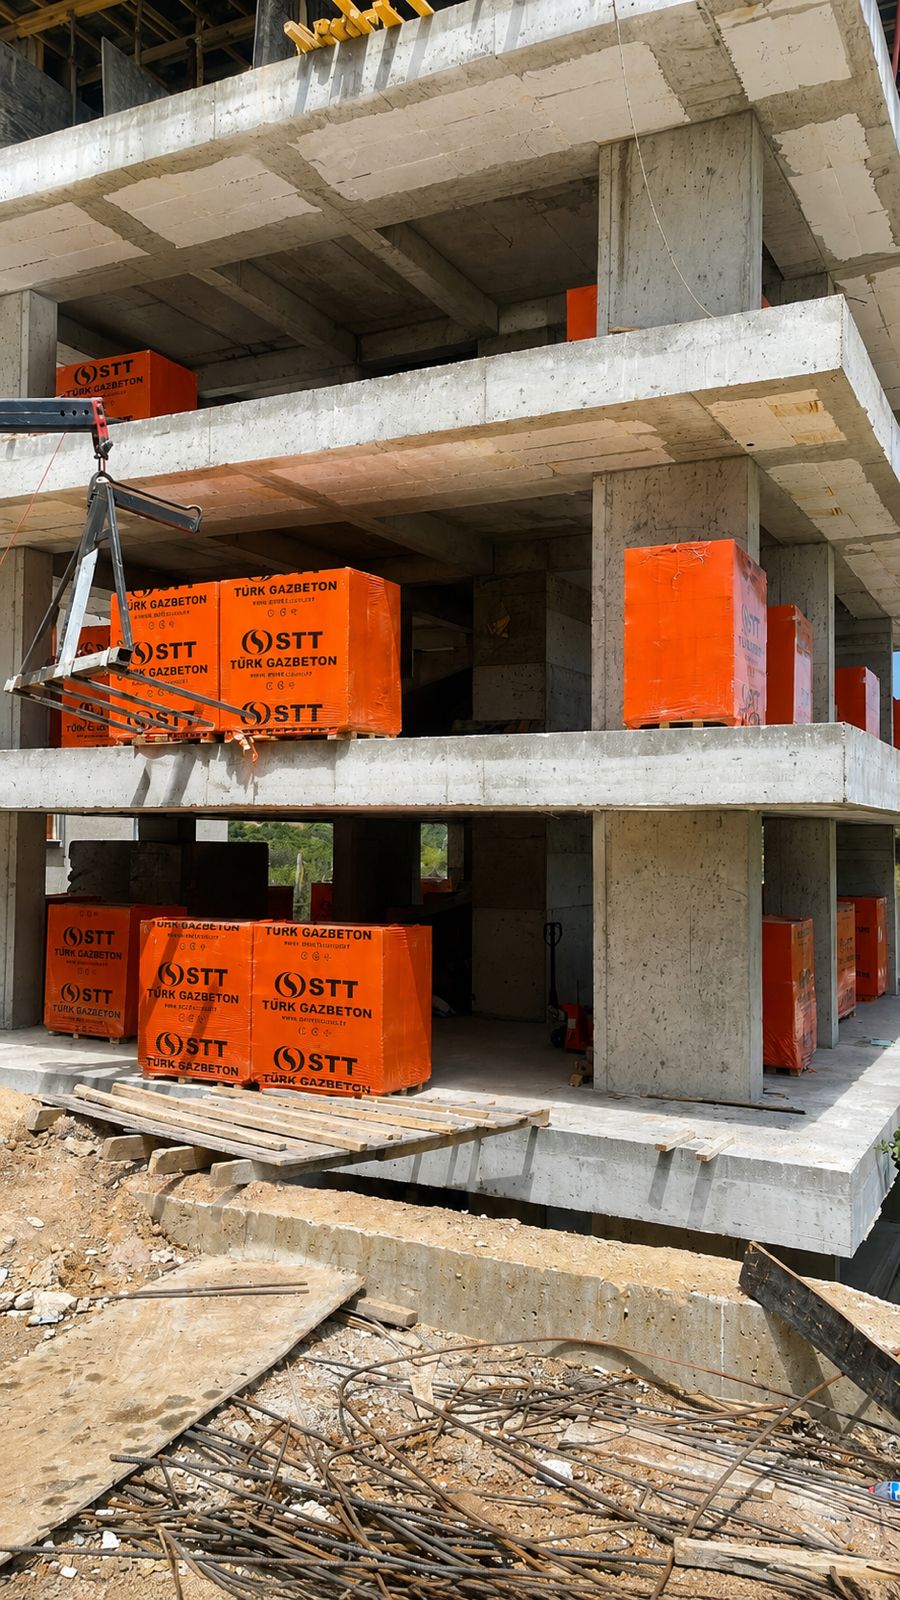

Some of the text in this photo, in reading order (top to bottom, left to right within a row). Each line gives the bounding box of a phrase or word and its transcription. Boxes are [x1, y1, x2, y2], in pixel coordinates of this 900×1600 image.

[100, 360, 133, 379] STT
[269, 581, 337, 595] GAZBETON
[150, 595, 207, 610] GAZBETON
[276, 631, 323, 650] STT
[156, 641, 197, 660] STT
[149, 664, 208, 677] GAZBETON
[230, 656, 337, 669] TÜRK GAZBETON
[274, 704, 323, 722] STT
[84, 929, 115, 945] STT
[302, 927, 372, 940] GAZBETON
[187, 967, 228, 987] STT
[82, 988, 113, 1005] STT
[309, 978, 358, 998] STT
[179, 991, 239, 1004] GAZBETON
[262, 998, 372, 1019] TÜRK GAZBETON
[186, 1037, 228, 1058] STT
[178, 1061, 239, 1076] GAZBETON
[308, 1053, 358, 1076] STT
[262, 1072, 371, 1093] TÜRK GAZBETON
